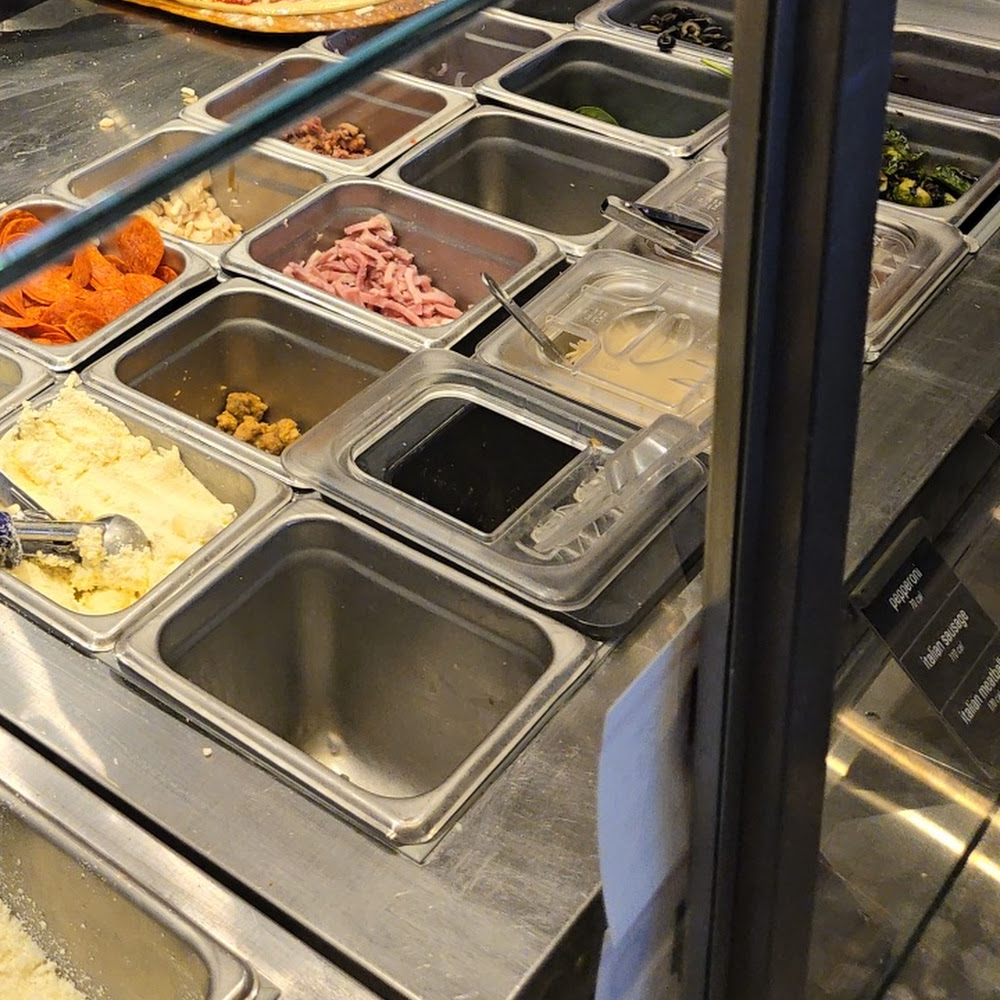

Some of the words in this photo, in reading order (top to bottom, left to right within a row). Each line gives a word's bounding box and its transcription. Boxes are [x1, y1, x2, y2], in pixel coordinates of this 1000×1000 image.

[888, 563, 923, 612] pepperoni
[919, 638, 945, 670] italian
[941, 608, 970, 646] sausage
[957, 692, 983, 725] italian
[978, 656, 1000, 699] meatba
